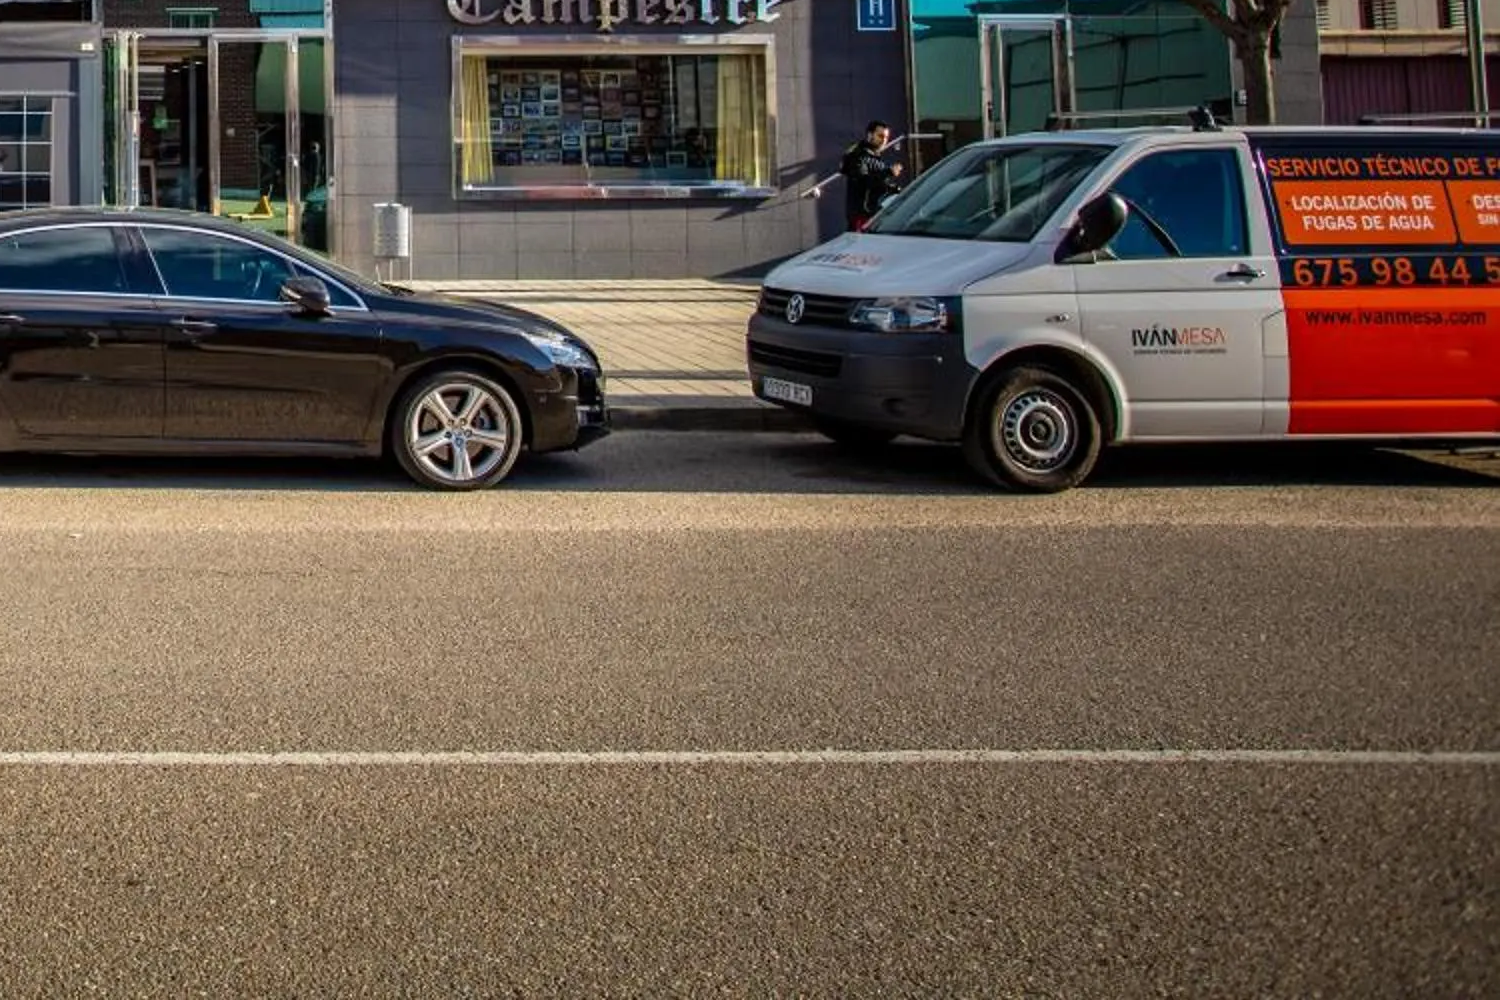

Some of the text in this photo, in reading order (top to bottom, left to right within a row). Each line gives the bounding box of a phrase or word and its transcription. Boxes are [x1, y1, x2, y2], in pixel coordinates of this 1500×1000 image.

[1267, 153, 1500, 177] SERVICIO TÉCNICO DE F
[1291, 192, 1436, 211] LOCALIZACIÓN DE
[1302, 214, 1435, 231] FUGAS DE AGUA
[1293, 256, 1359, 286] 675
[1370, 256, 1416, 286] 98
[1428, 256, 1472, 286] 44
[1306, 307, 1487, 326] www.ivanmesa.com
